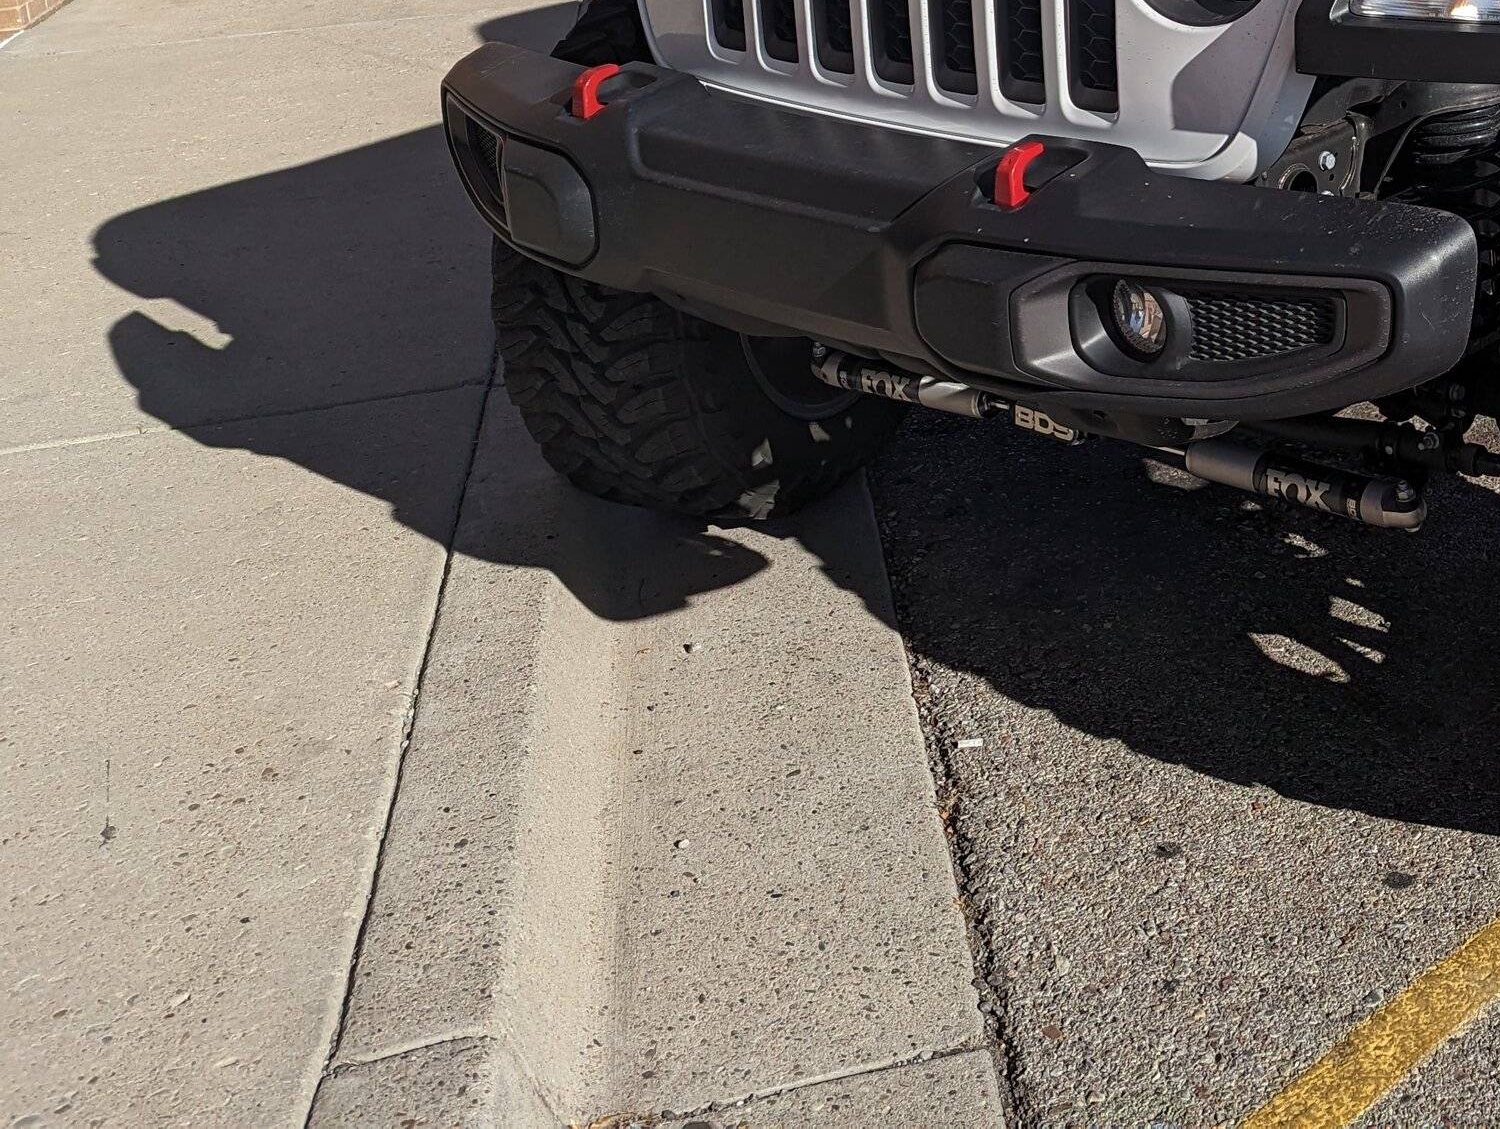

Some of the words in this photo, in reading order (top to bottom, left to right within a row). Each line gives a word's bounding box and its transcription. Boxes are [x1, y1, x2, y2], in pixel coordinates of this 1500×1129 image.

[861, 369, 912, 402] FOX
[1014, 406, 1075, 442] BDS
[1266, 469, 1332, 512] FOX
